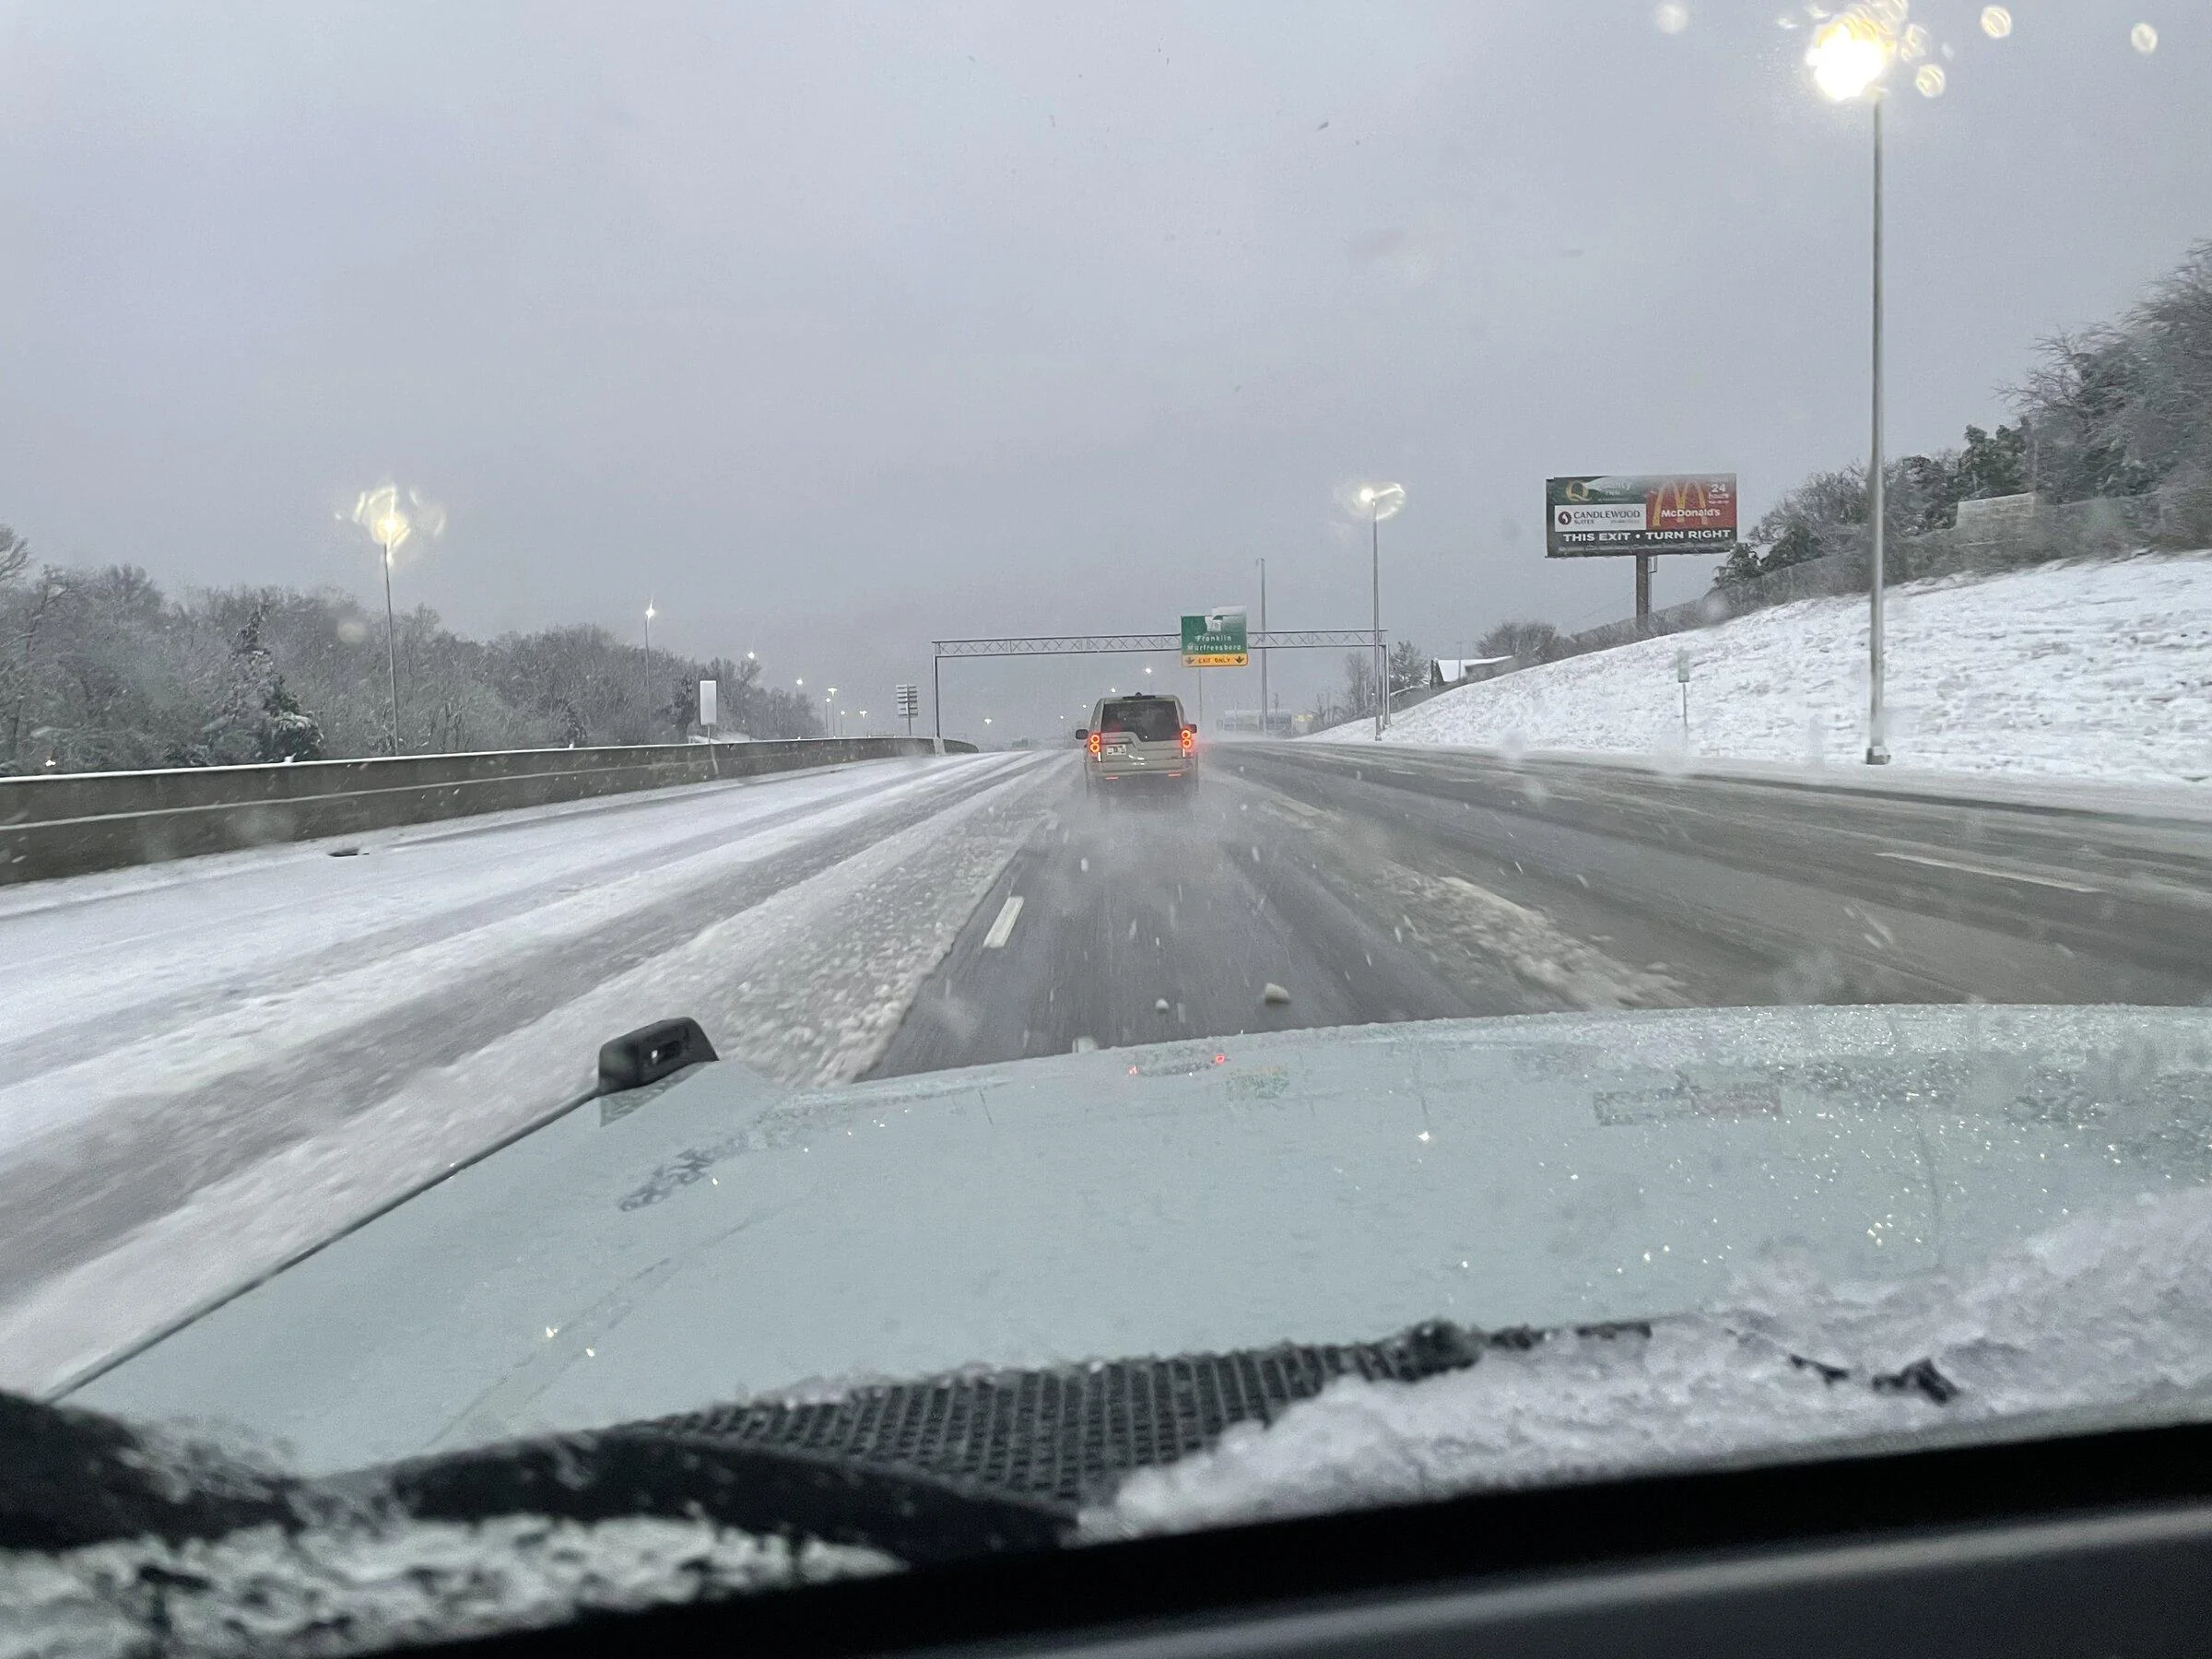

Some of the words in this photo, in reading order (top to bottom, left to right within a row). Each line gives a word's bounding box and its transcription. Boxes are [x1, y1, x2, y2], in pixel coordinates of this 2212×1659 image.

[1711, 483, 1726, 492] 24
[1573, 510, 1641, 519] CANDLEWOOD
[1661, 508, 1721, 518] McDonald's
[1562, 533, 1595, 542] THIS
[1599, 532, 1631, 541] EXIT
[1645, 531, 1684, 540] TURN
[1688, 529, 1731, 539] RIGHT
[1194, 634, 1231, 642] Franklin
